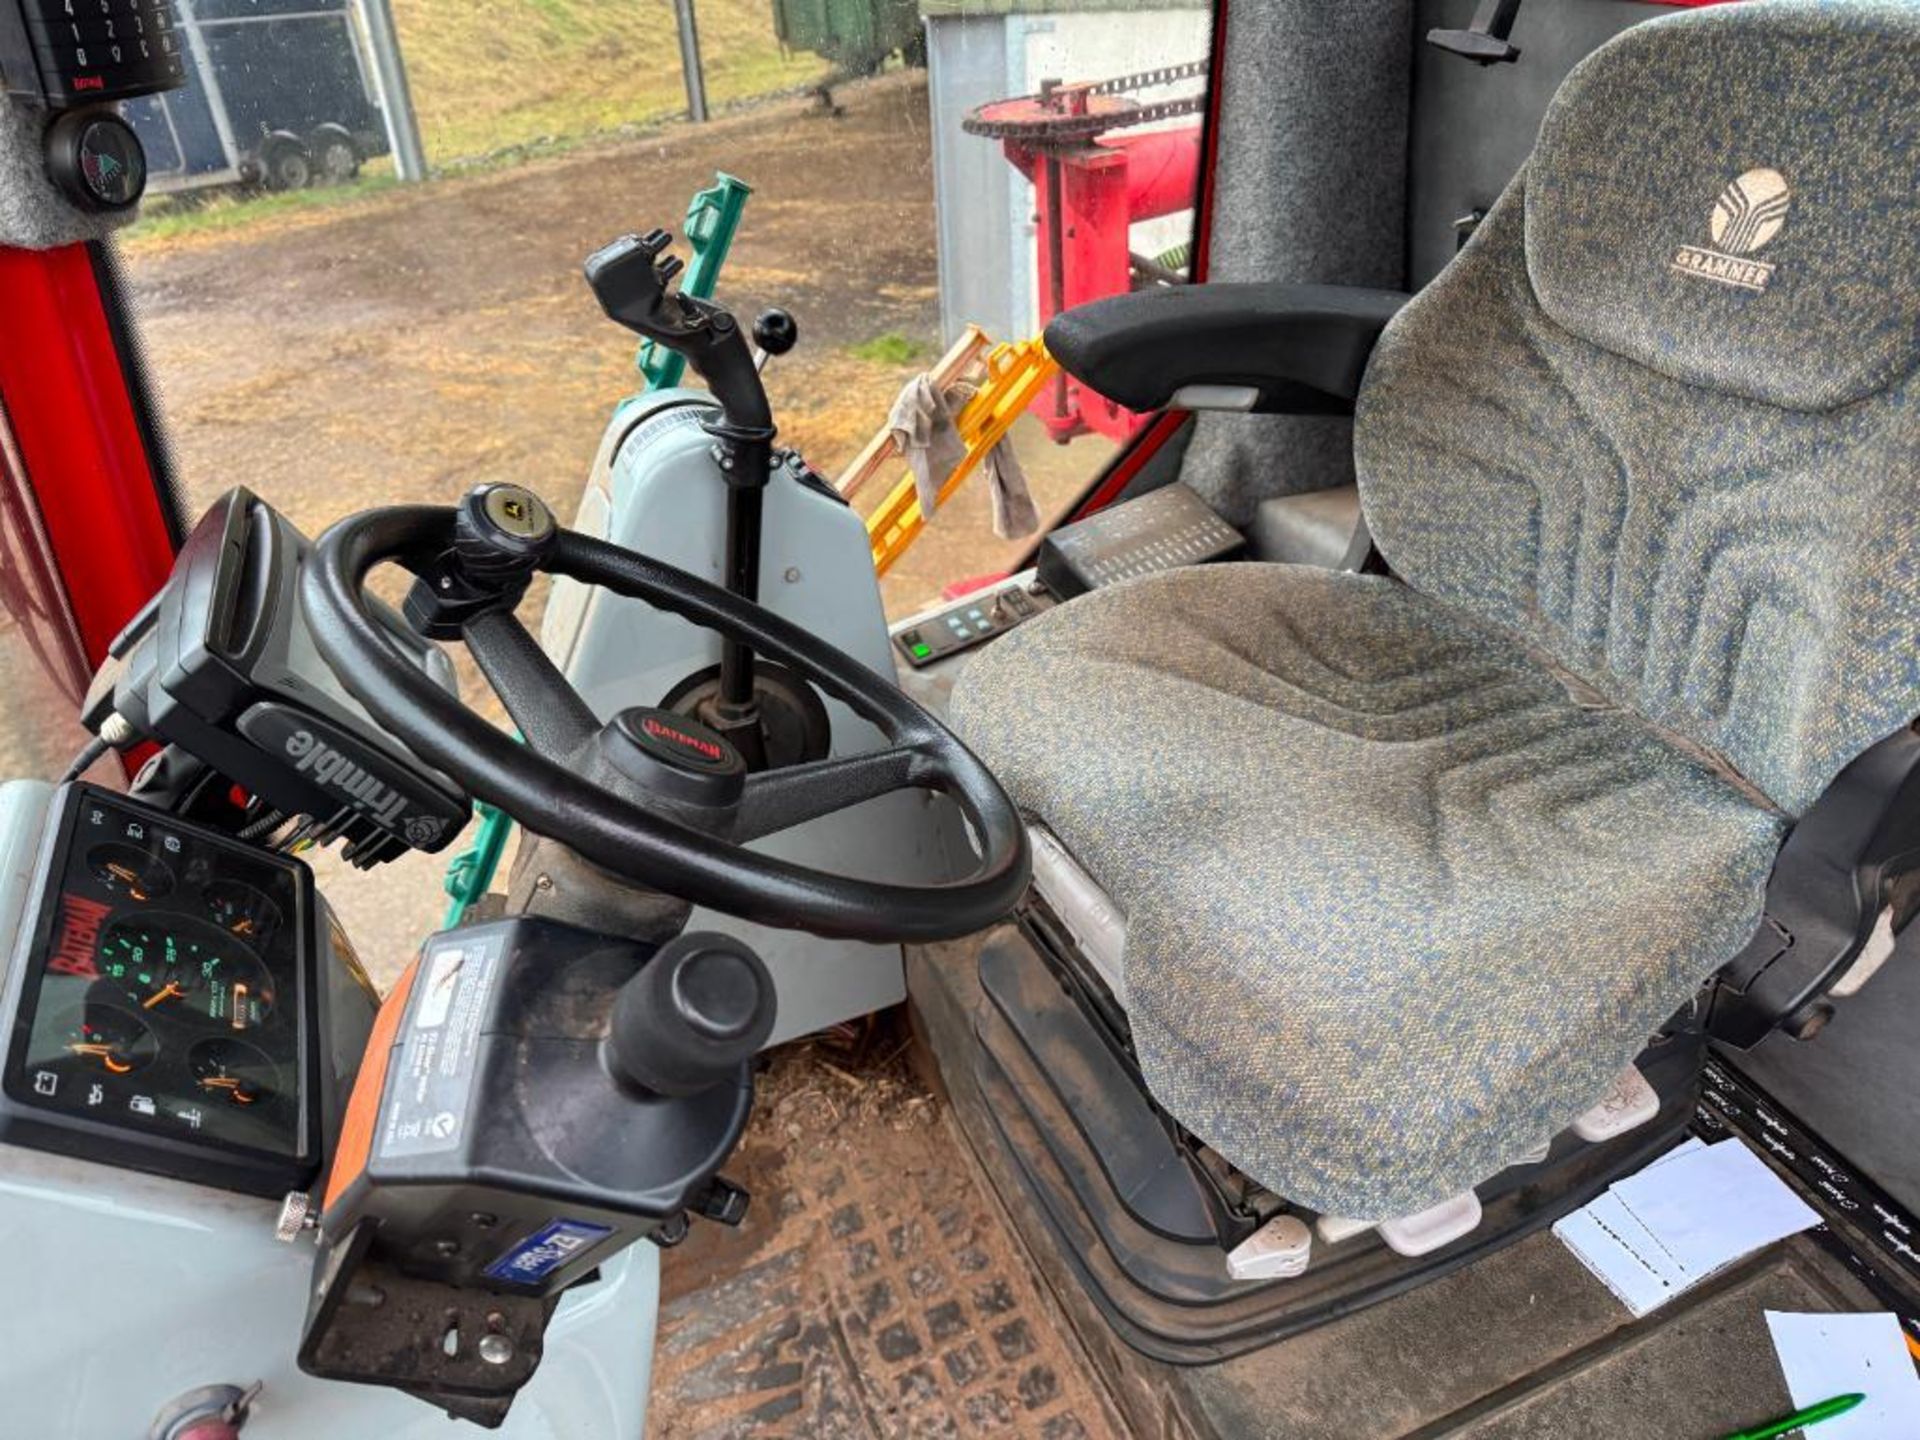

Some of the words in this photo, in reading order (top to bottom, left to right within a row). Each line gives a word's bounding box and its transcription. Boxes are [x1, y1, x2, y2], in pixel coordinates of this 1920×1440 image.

[1675, 251, 1769, 285] GRAMMER
[642, 718, 722, 760] BATEMAN
[286, 731, 408, 828] Trimble
[49, 891, 113, 978] BATEMAN
[132, 946, 144, 963] 20
